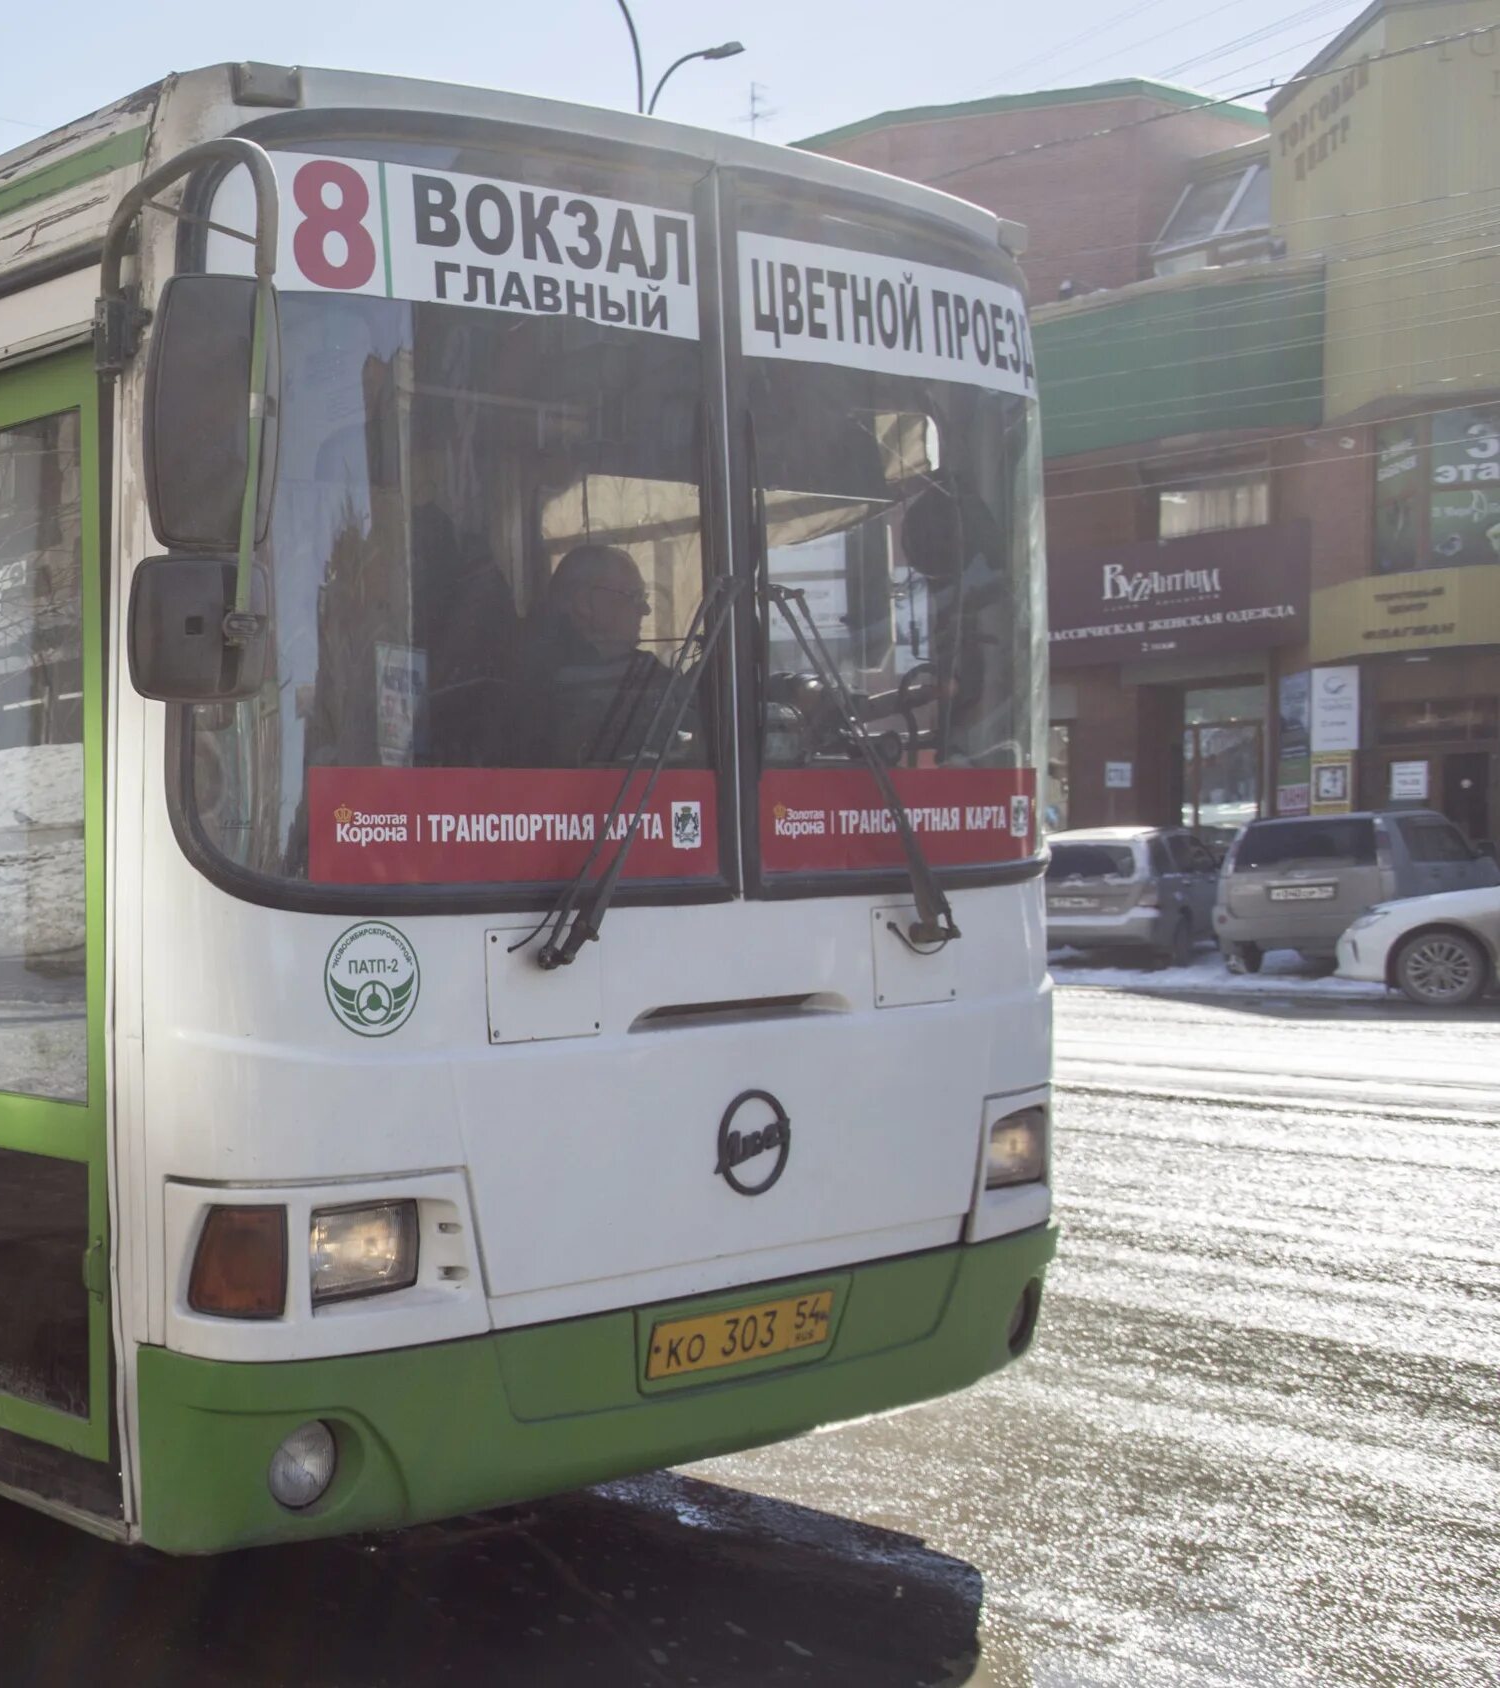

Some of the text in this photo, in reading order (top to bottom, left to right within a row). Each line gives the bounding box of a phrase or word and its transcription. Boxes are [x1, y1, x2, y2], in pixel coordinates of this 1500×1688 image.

[292, 159, 376, 289] 8
[412, 173, 690, 286] ВОКЗАЛ
[434, 261, 669, 331] ГЛАВНЫЙ
[751, 258, 1034, 389] ЦВЕТНОЙ ПРОЕЗД
[1466, 424, 1500, 458] 3
[1147, 613, 1223, 631] ЖЕНСКАЯ
[1226, 604, 1296, 623] ОДЕЖДА
[353, 811, 407, 826] Золотая
[428, 813, 594, 843] ТРАНСПОРТНАЯ
[786, 808, 824, 820] Золотая
[965, 806, 1006, 830] КАРТА
[336, 823, 407, 847] Корона
[775, 819, 825, 839] Корона
[348, 958, 399, 975] ПАТП-2
[666, 1297, 820, 1369] КО 303 54
